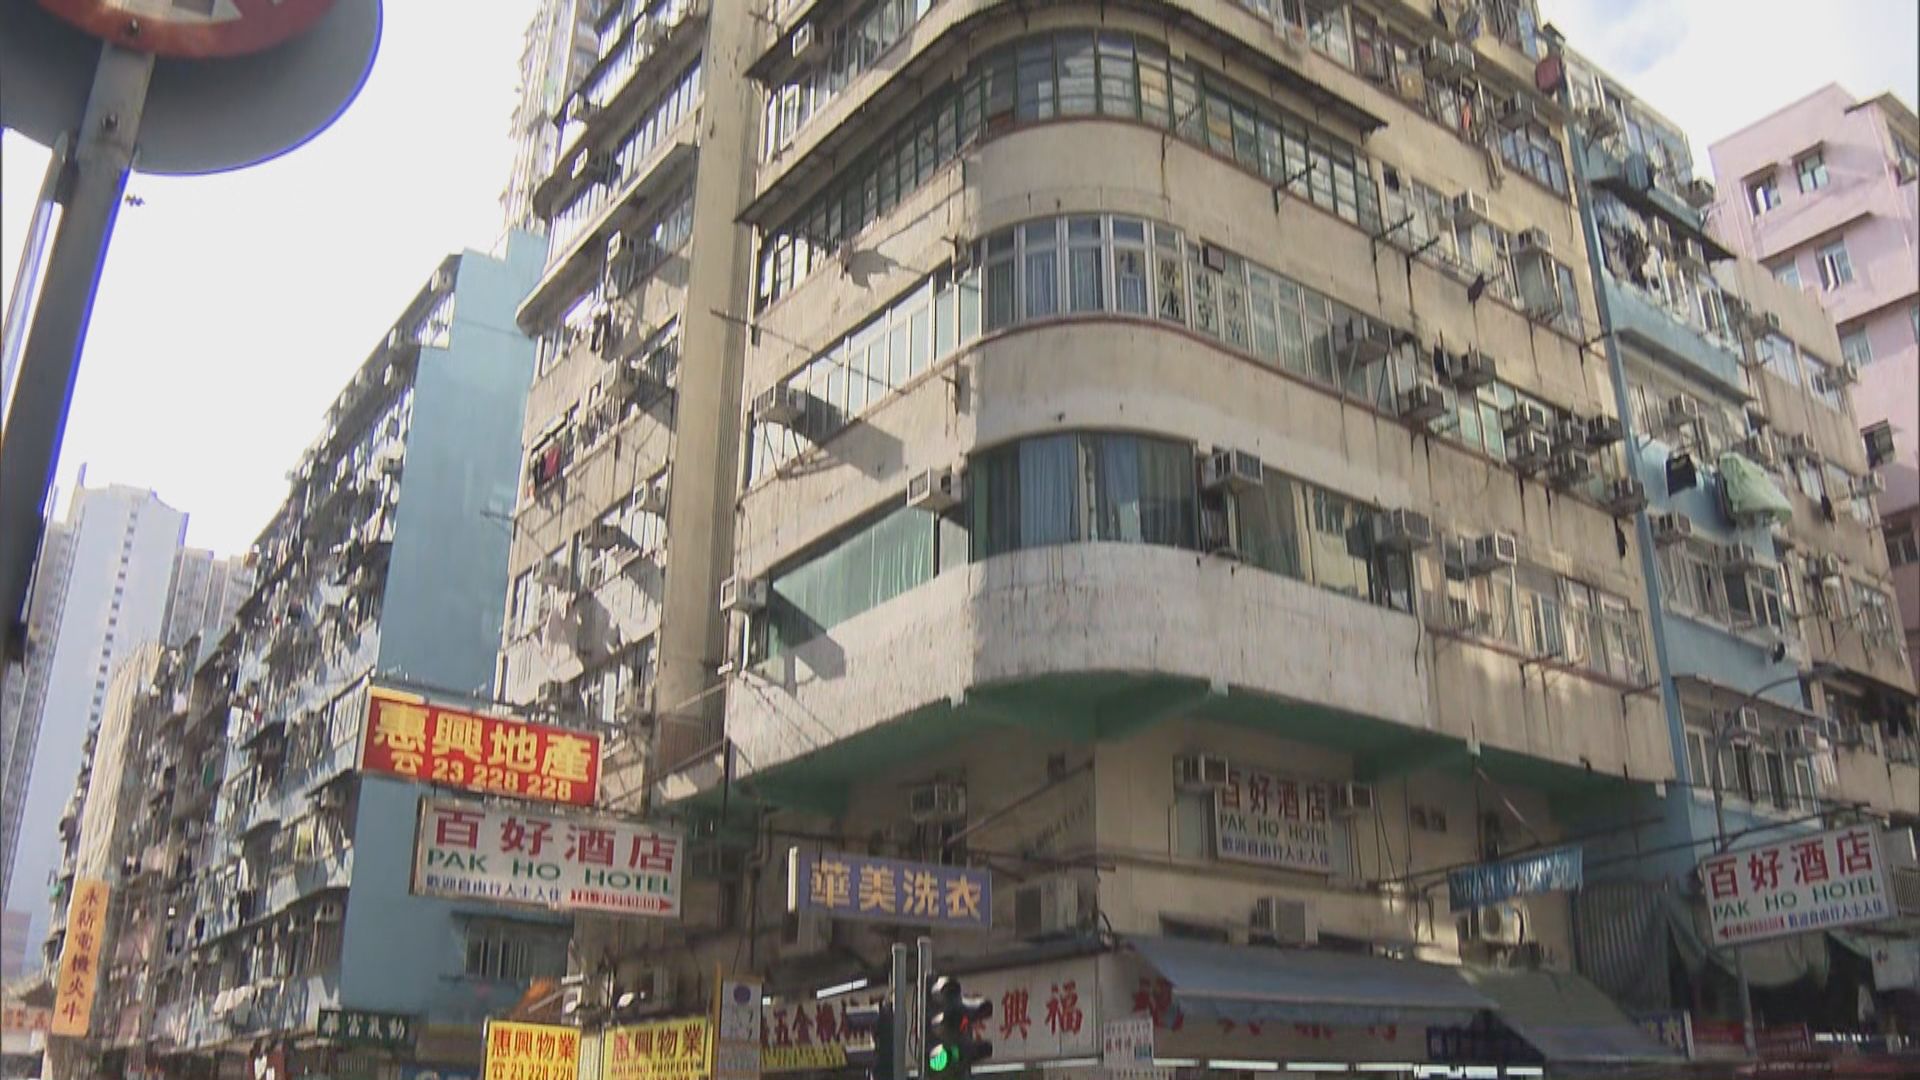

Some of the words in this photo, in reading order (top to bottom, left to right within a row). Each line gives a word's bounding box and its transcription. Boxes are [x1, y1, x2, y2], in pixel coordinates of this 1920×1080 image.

[374, 702, 592, 783] 惠興地產
[432, 757, 464, 785] 23
[473, 764, 519, 793] 228
[527, 774, 572, 801] 228
[1222, 770, 1326, 824] 百好酒店
[434, 807, 678, 873] 百好酒店
[1219, 813, 1246, 833] PAK
[1257, 819, 1279, 838] HO
[1289, 824, 1328, 846] HOTEL
[427, 848, 488, 873] PAK
[513, 859, 561, 881] HO
[585, 868, 673, 895] HOTEL
[1705, 830, 1873, 898] 百好酒店
[810, 858, 981, 921] 華美洗衣
[1713, 900, 1750, 921] PAK
[1765, 890, 1797, 912] HO
[1812, 877, 1879, 903] HOTEL
[492, 1027, 577, 1064] 惠興物業
